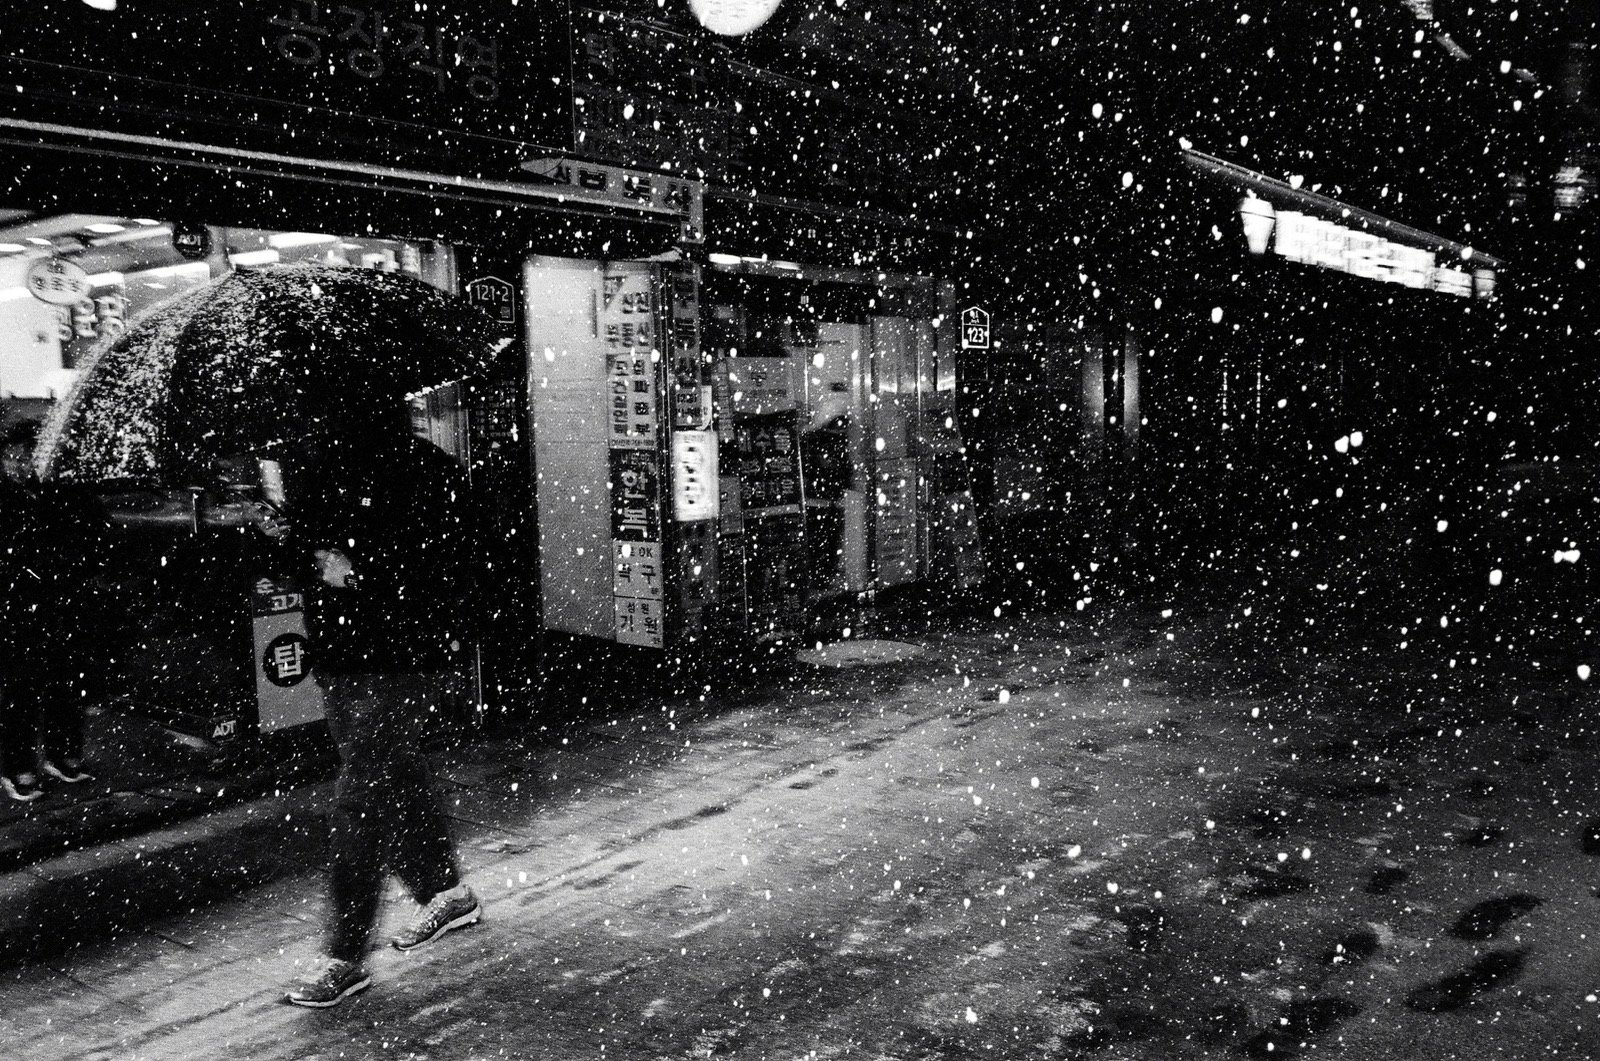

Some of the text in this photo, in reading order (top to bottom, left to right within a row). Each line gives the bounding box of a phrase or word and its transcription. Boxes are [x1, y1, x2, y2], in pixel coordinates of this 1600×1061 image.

[967, 327, 984, 343] 123
[638, 547, 654, 558] OK
[620, 615, 659, 635] 기원
[211, 719, 238, 739] ADT
